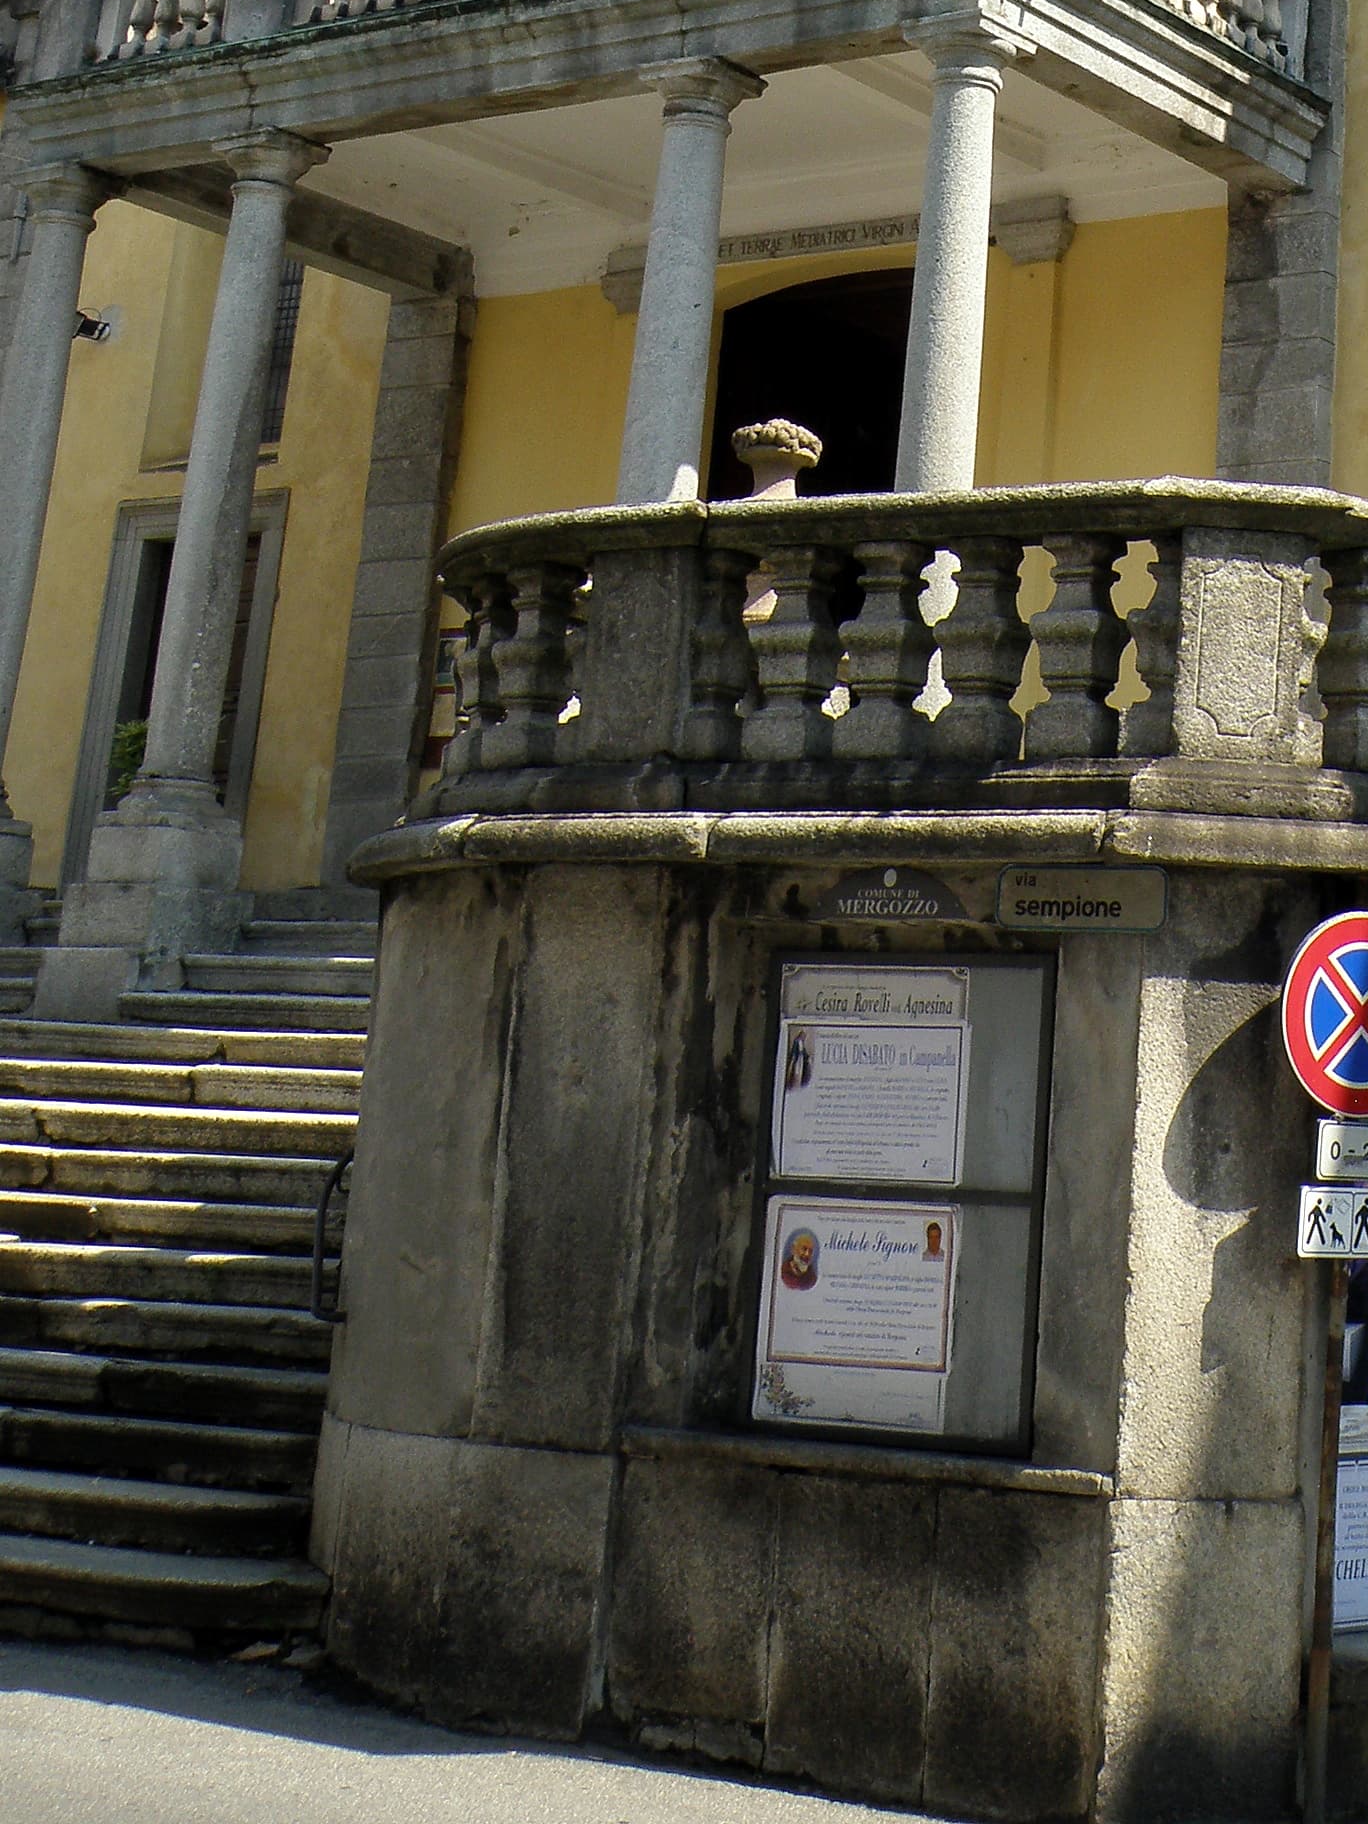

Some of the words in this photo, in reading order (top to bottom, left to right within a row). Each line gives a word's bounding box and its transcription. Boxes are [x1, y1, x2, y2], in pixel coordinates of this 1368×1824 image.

[1015, 874, 1037, 887] via
[857, 888, 903, 898] COMUNE
[907, 890, 920, 898] DI
[836, 898, 939, 916] MERGOZZO
[1015, 895, 1122, 920] sempione
[815, 991, 848, 1012] Cesira
[1330, 1141, 1341, 1161] 0
[824, 1230, 869, 1252] Michele
[872, 1230, 919, 1262] Signore
